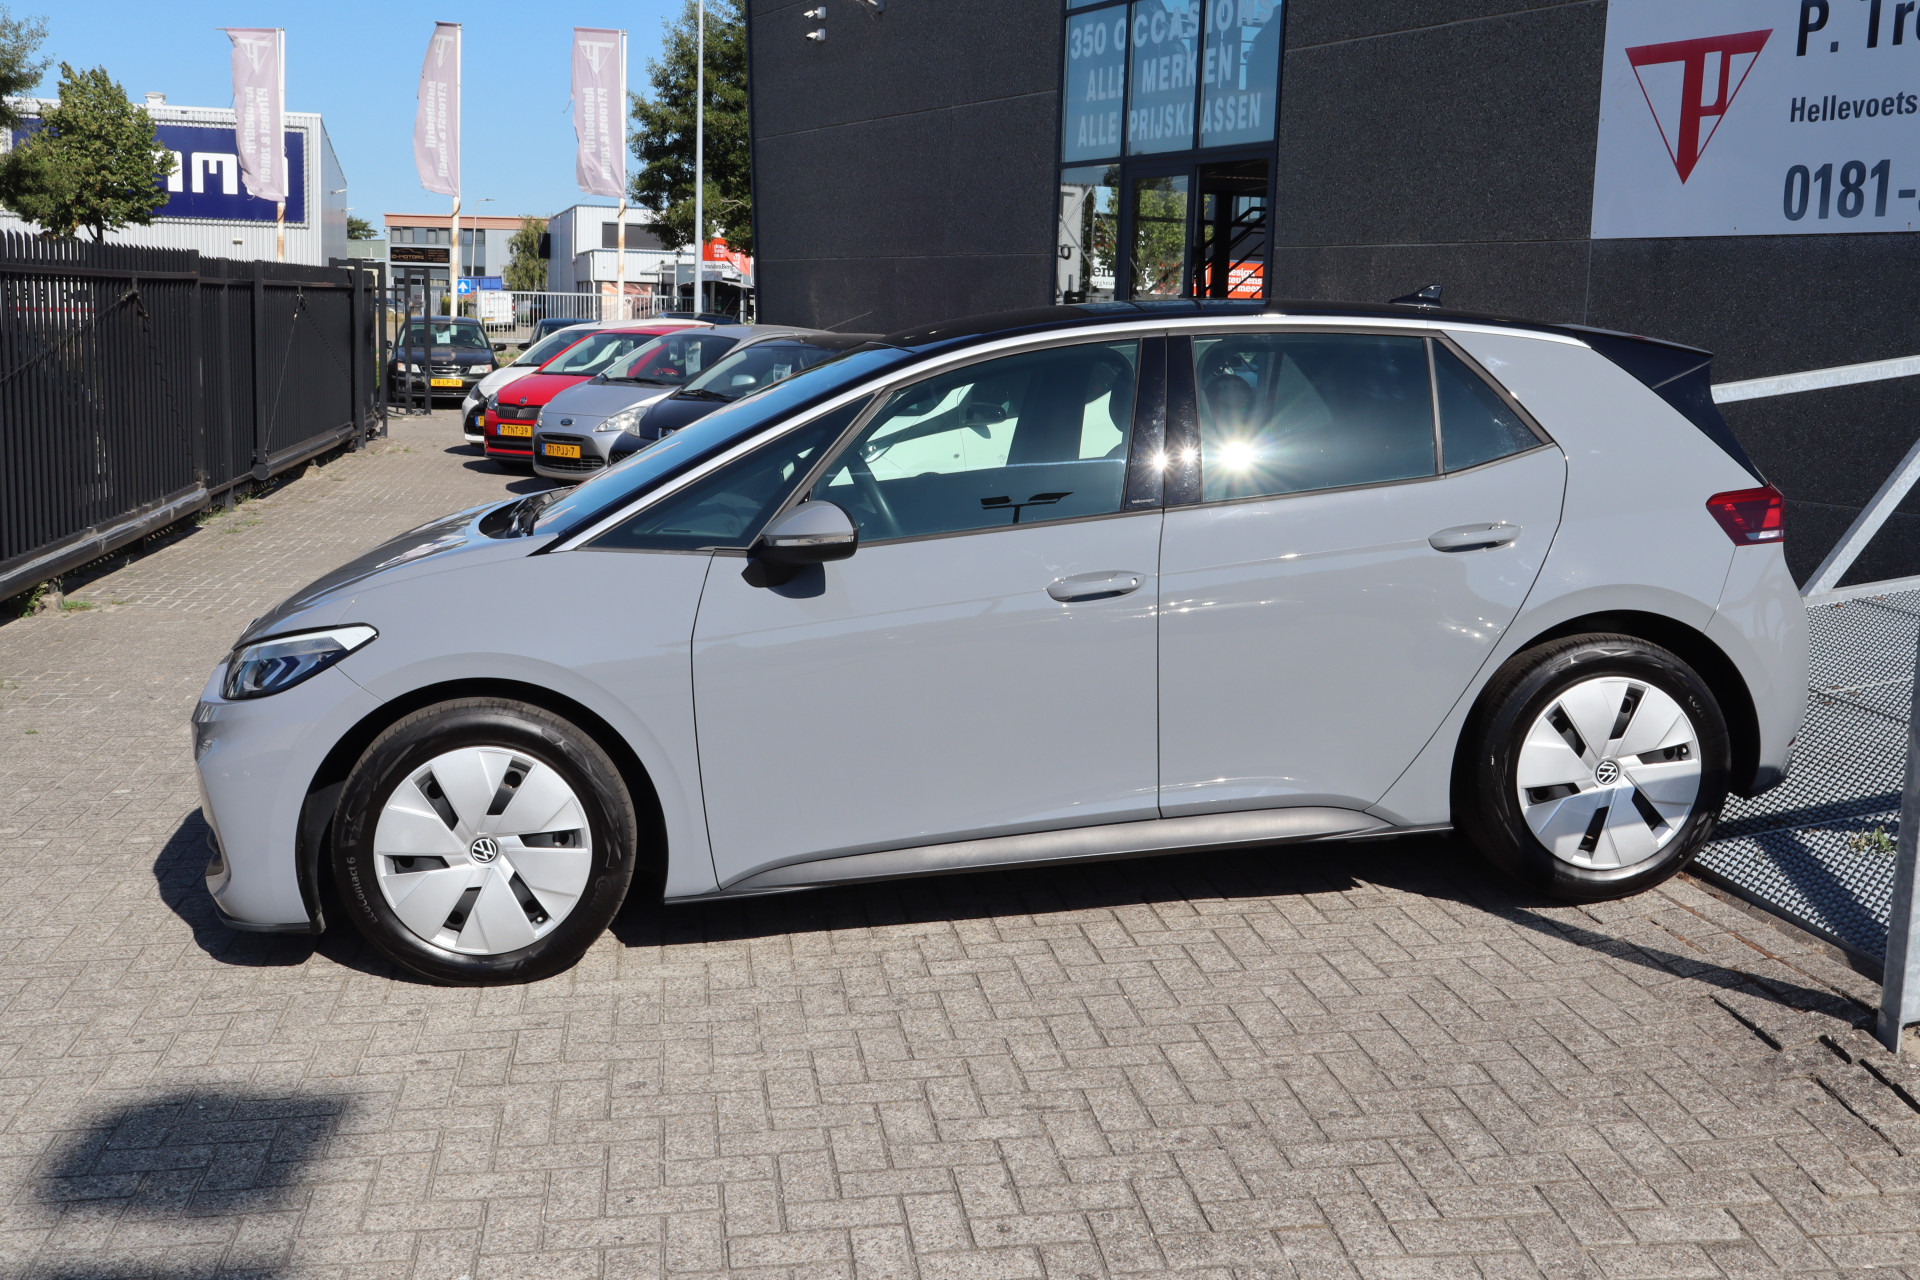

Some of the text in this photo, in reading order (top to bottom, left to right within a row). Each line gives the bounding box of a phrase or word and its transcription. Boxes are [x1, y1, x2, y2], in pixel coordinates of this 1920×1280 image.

[1071, 0, 1274, 60] 350 OCCASIONS
[1796, 0, 1920, 57] P. Tr
[1086, 45, 1233, 102] ALLE MERKEN
[1077, 92, 1261, 148] ALLE PRIJSKLASSEN
[1790, 91, 1920, 122] Hellevoets
[1783, 159, 1920, 221] 0181-
[501, 425, 529, 436] 7-TNT-39
[547, 444, 575, 456] 71-PJJ-7
